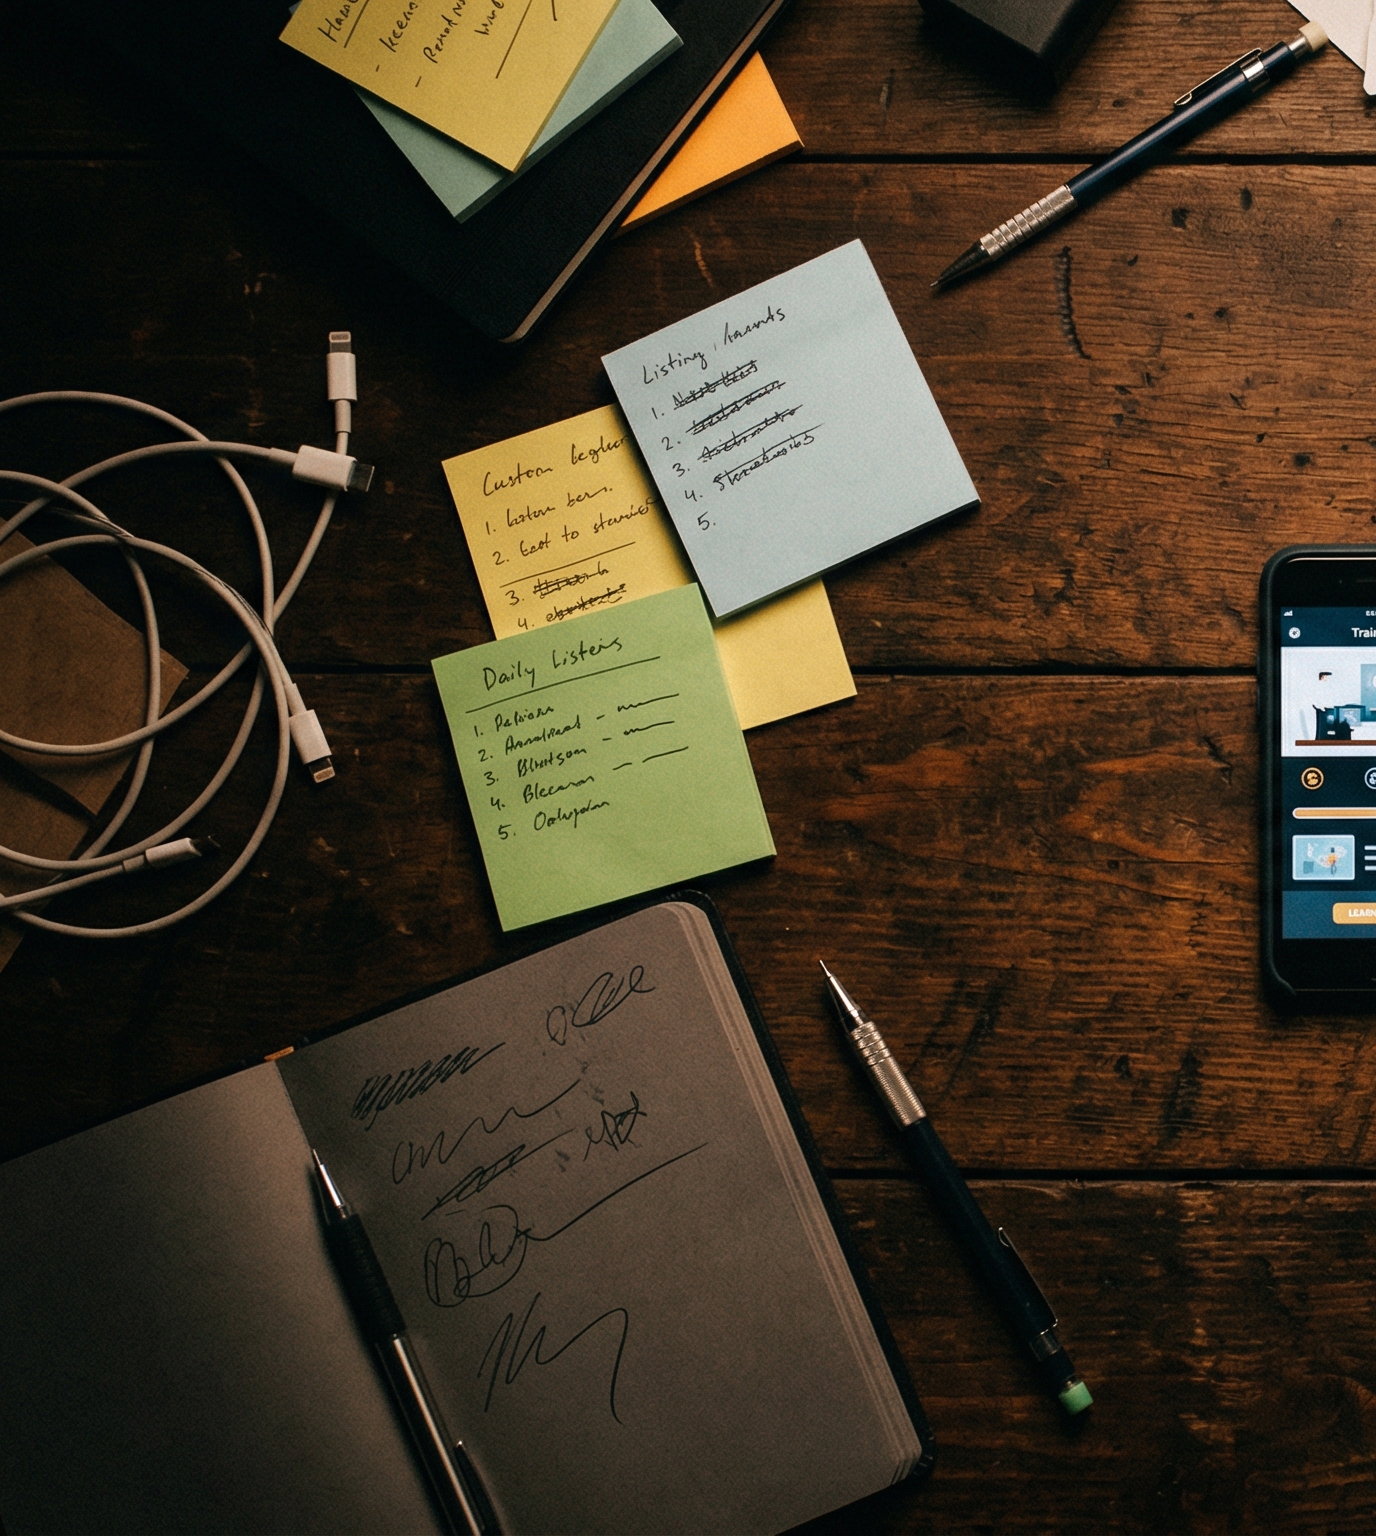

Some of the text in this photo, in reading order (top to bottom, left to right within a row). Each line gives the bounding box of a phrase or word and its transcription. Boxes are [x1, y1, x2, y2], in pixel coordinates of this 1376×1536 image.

[651, 407, 665, 420] 1.
[661, 437, 681, 451] 2.
[672, 463, 691, 477] 3.
[684, 489, 704, 502] 4.
[485, 521, 497, 535] 1.
[697, 512, 716, 530] 5.
[492, 551, 510, 566] 2.
[505, 590, 525, 606] 3.
[517, 617, 535, 631] 4.
[483, 661, 535, 691] Daily
[473, 725, 484, 737] 1.
[478, 749, 494, 762] 2.
[483, 771, 499, 786] 3.
[490, 797, 506, 812] 4.
[498, 824, 516, 840] 5.
